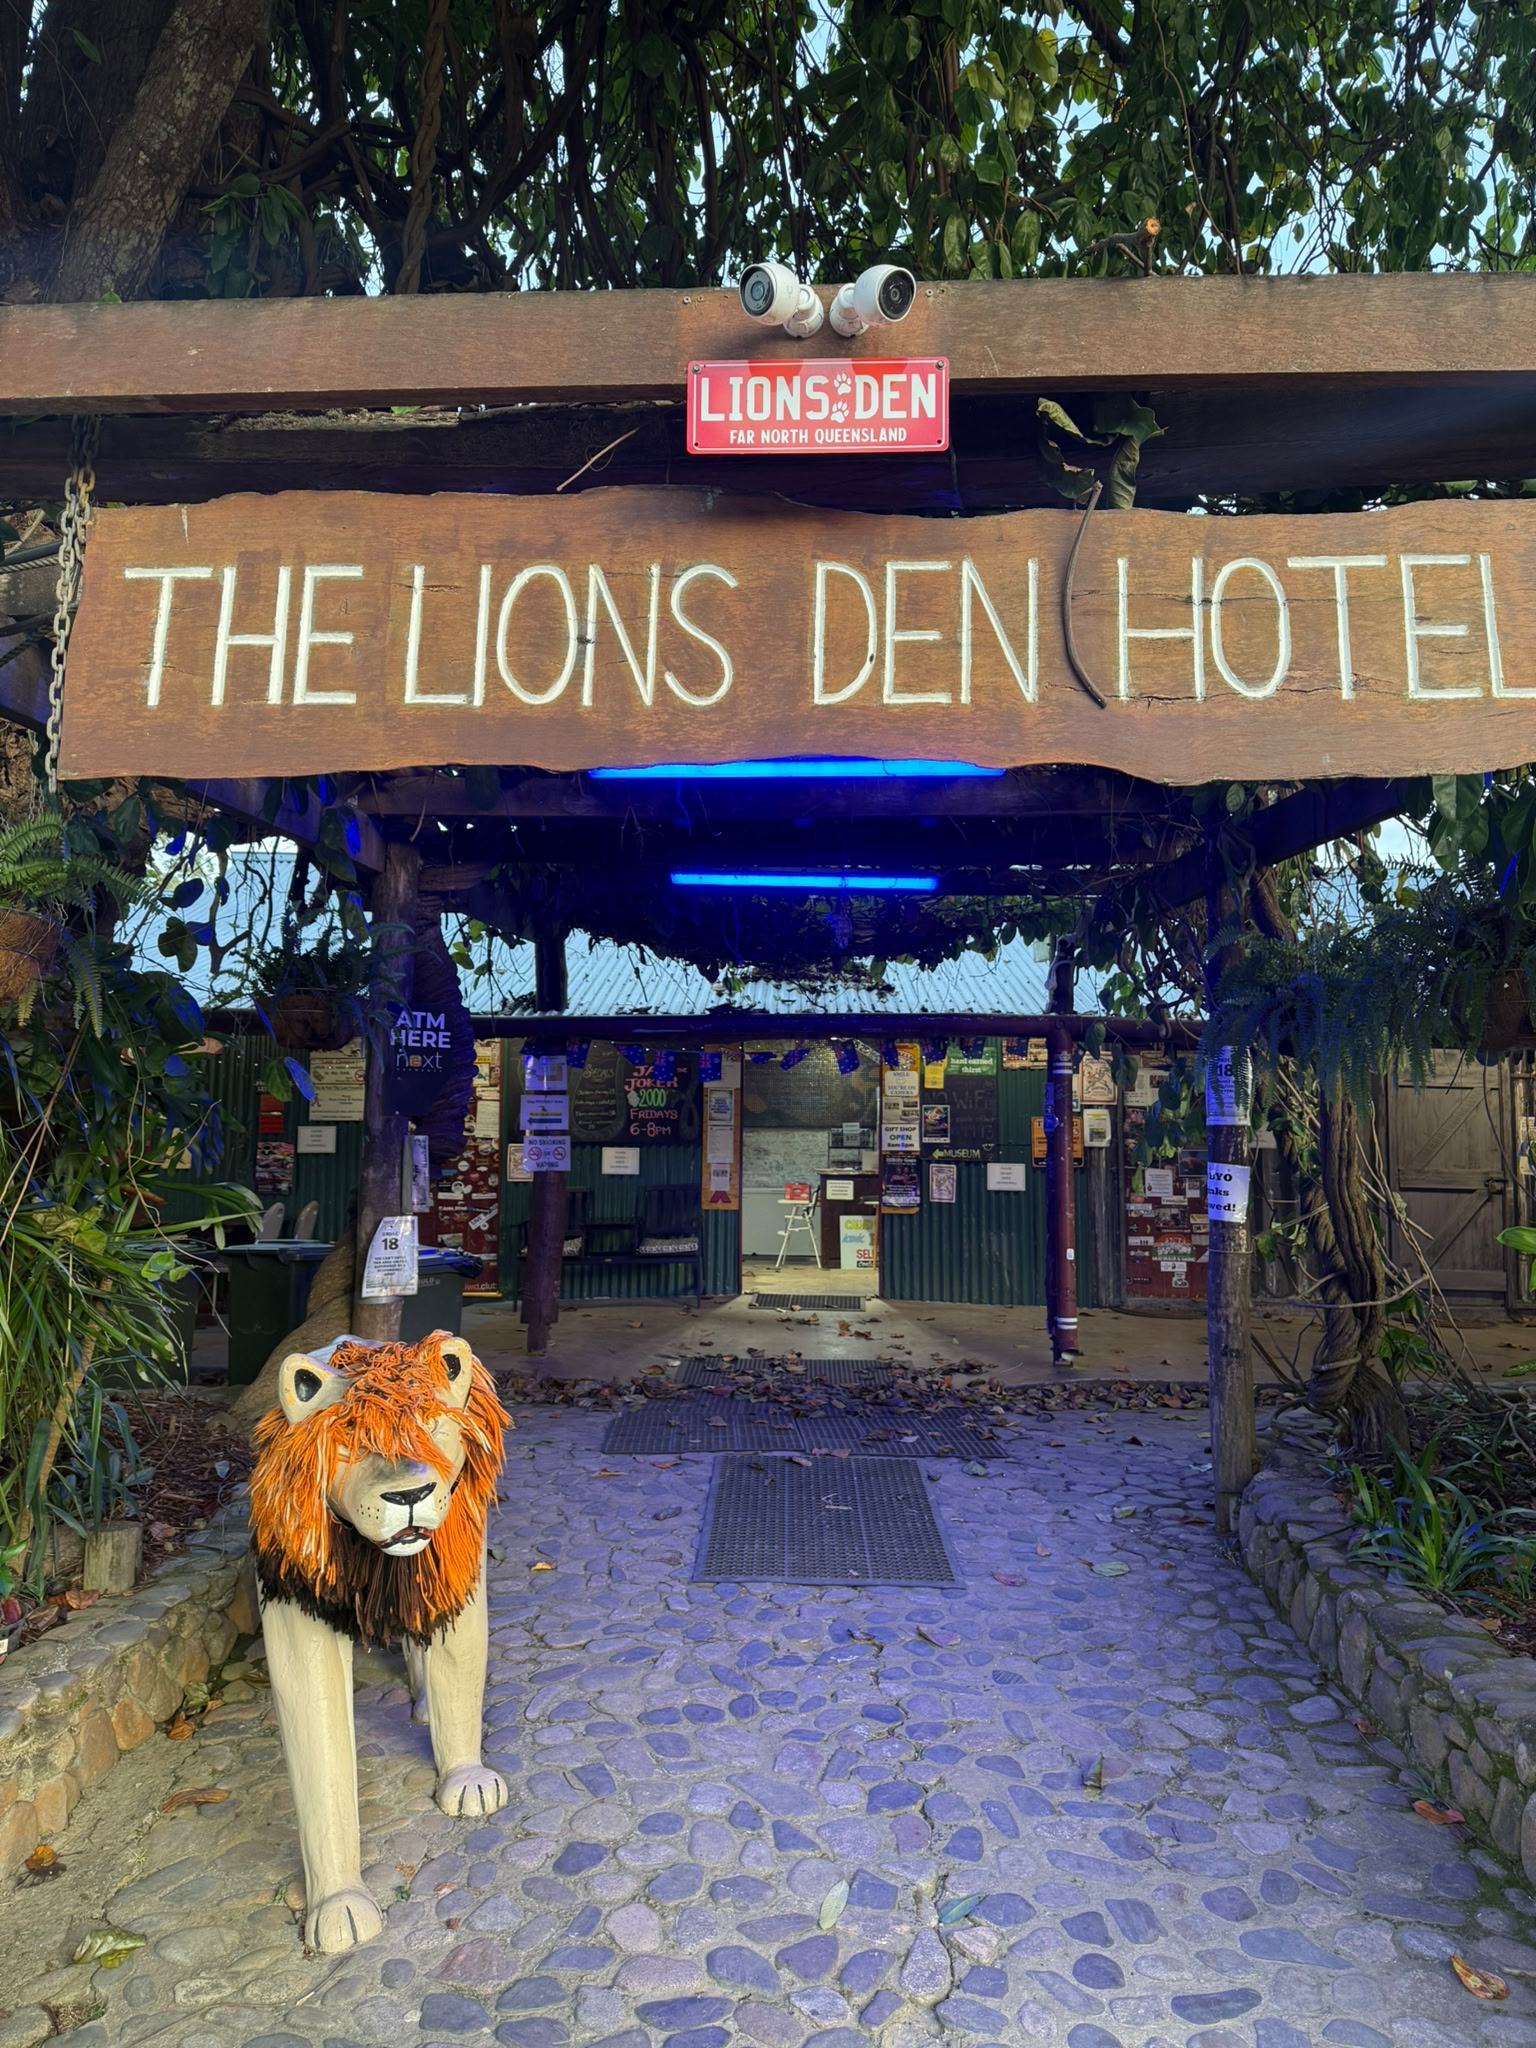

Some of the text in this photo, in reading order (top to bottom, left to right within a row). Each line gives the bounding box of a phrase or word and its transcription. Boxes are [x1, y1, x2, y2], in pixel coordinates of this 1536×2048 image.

[701, 373, 937, 421] LIONS DEN
[730, 427, 907, 444] FAR NORTH QUEENSLAND
[123, 552, 1536, 707] THE LIONS DEN HOTEL
[395, 1010, 446, 1030] ATM
[389, 1028, 452, 1049] HERE
[1217, 1064, 1234, 1077] 18
[889, 1133, 913, 1141] OPEN
[943, 1148, 981, 1159] MUSEUM
[381, 1237, 399, 1250] 18
